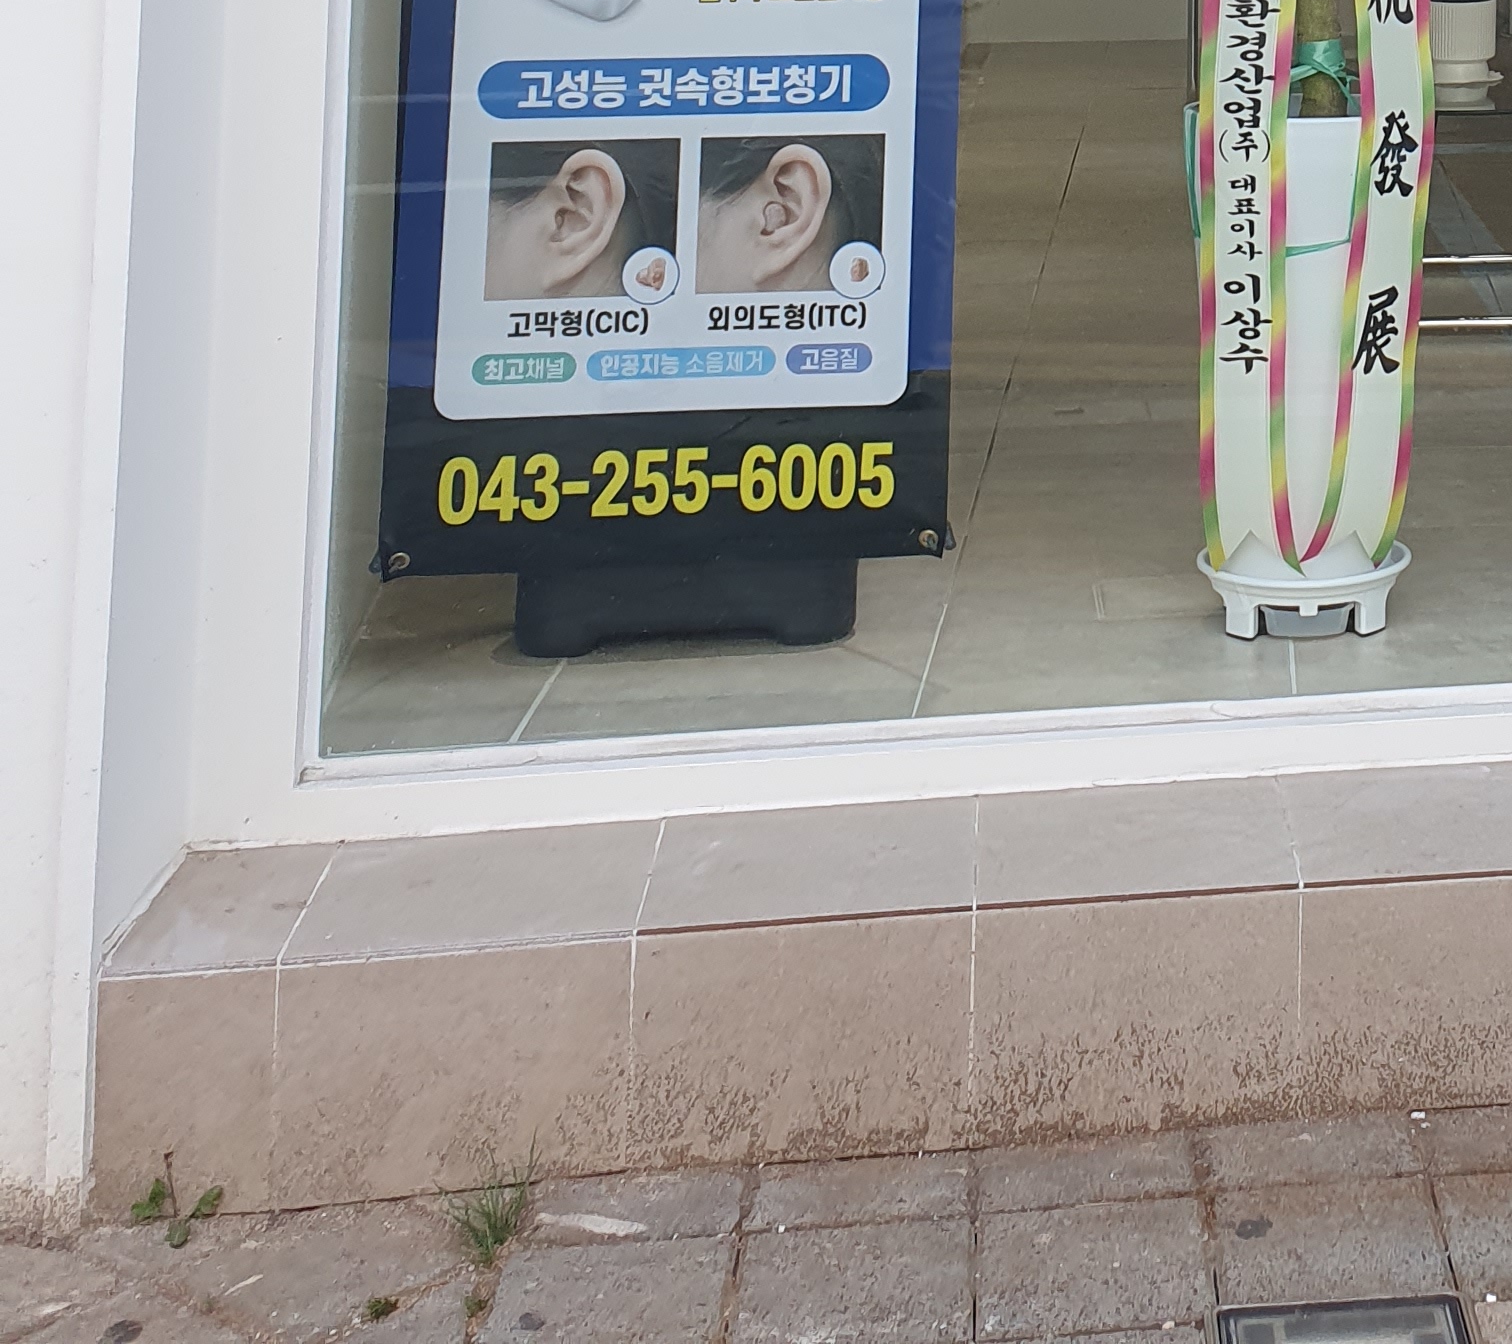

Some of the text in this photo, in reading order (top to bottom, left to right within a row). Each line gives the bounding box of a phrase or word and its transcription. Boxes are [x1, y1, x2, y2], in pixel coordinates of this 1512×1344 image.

[517, 64, 852, 109] 고성능 귓속형보청기
[1225, 174, 1263, 259] 대표이사
[506, 308, 649, 339] 고막형(CIC)
[707, 302, 867, 332] 외의도형(ITC)
[1218, 272, 1274, 375] 이상수
[484, 357, 564, 380] 최고채널
[600, 351, 764, 376] 인공지능 소음제거
[800, 347, 856, 372] 고음질
[437, 441, 895, 525] 043-255-6005
